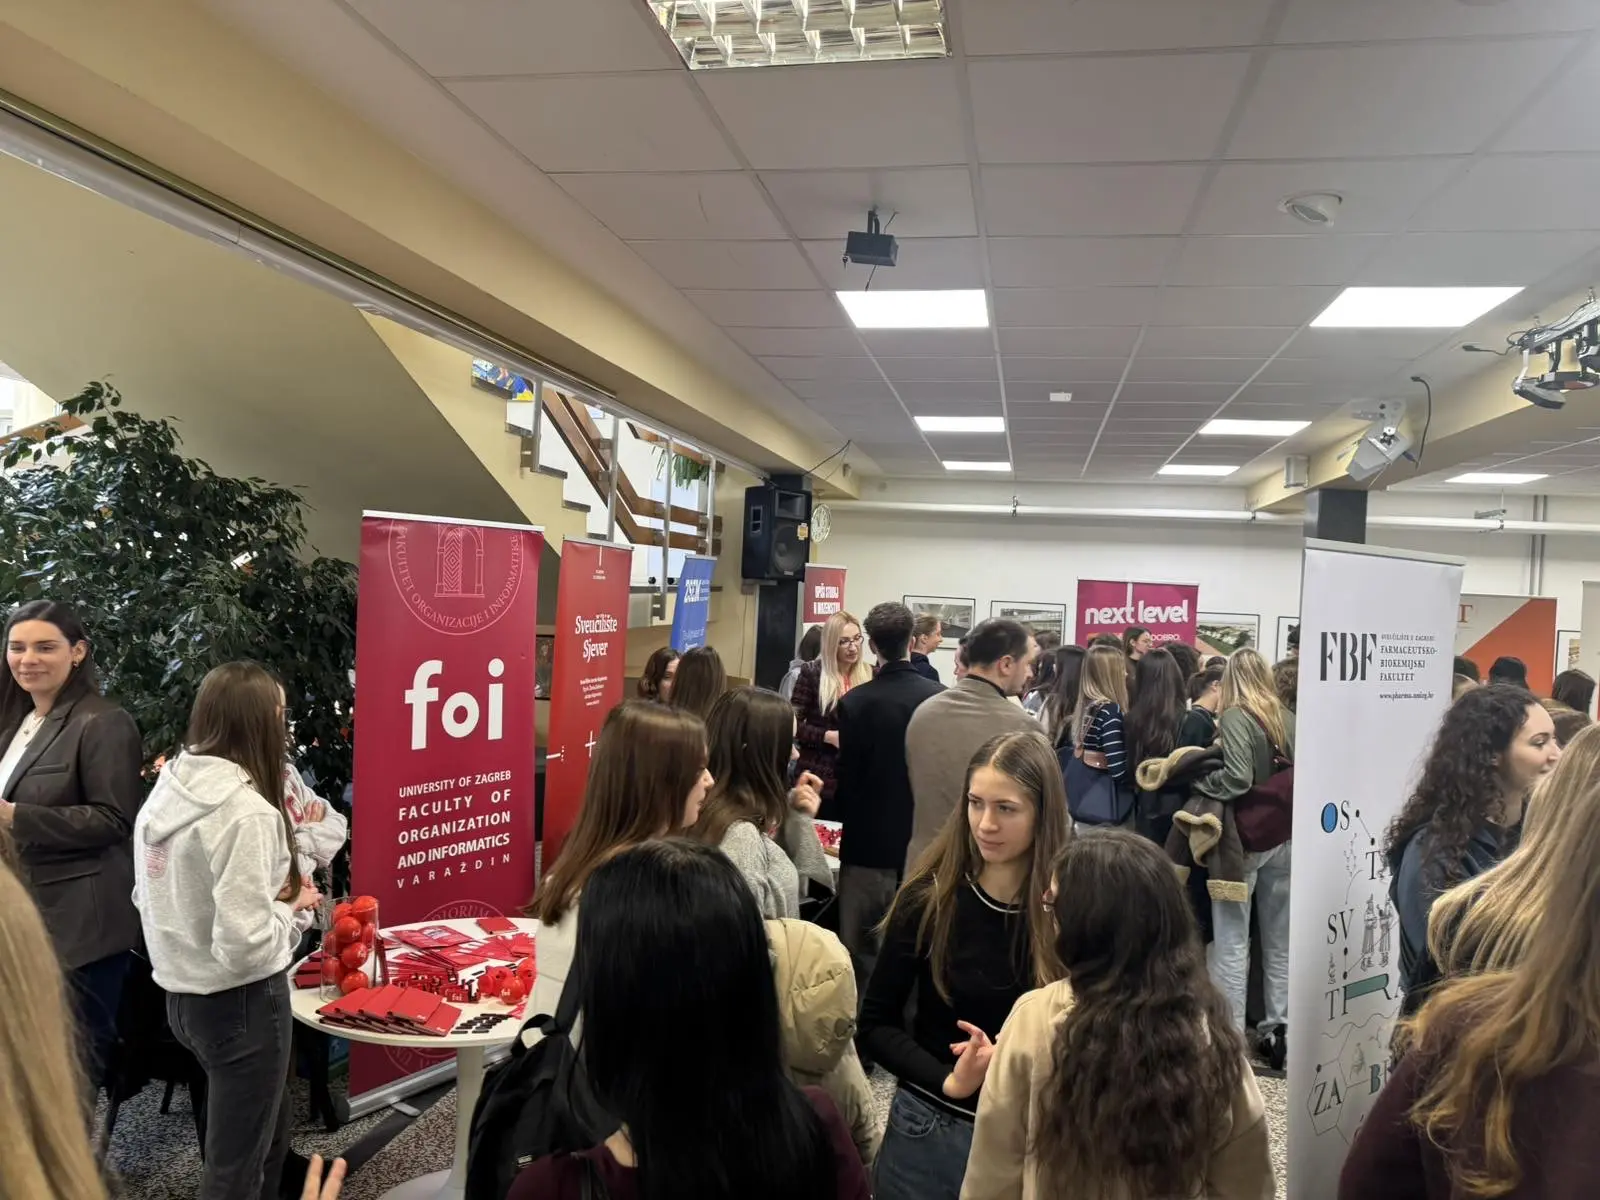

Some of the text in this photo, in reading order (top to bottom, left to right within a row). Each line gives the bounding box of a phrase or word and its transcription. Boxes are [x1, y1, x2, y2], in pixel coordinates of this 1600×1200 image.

[411, 593, 484, 629] ORGANIZACIJE
[1085, 582, 1188, 625] next level
[575, 613, 618, 634] Sveučilište
[583, 639, 608, 663] Sjever
[1320, 632, 1377, 682] FBF
[1380, 645, 1438, 655] FARMACEUTSKO-
[1380, 659, 1426, 670] BIOKEMIJSKI
[1380, 672, 1415, 682] FAKULTET
[404, 658, 504, 750] foi
[399, 770, 512, 798] UNIVERSITY OF ZAGREB
[398, 789, 511, 821] FACULTY OF
[398, 811, 511, 845] ORGANIZATION
[397, 832, 511, 870] AND INFORMATICS
[1313, 1077, 1342, 1117] ZA
